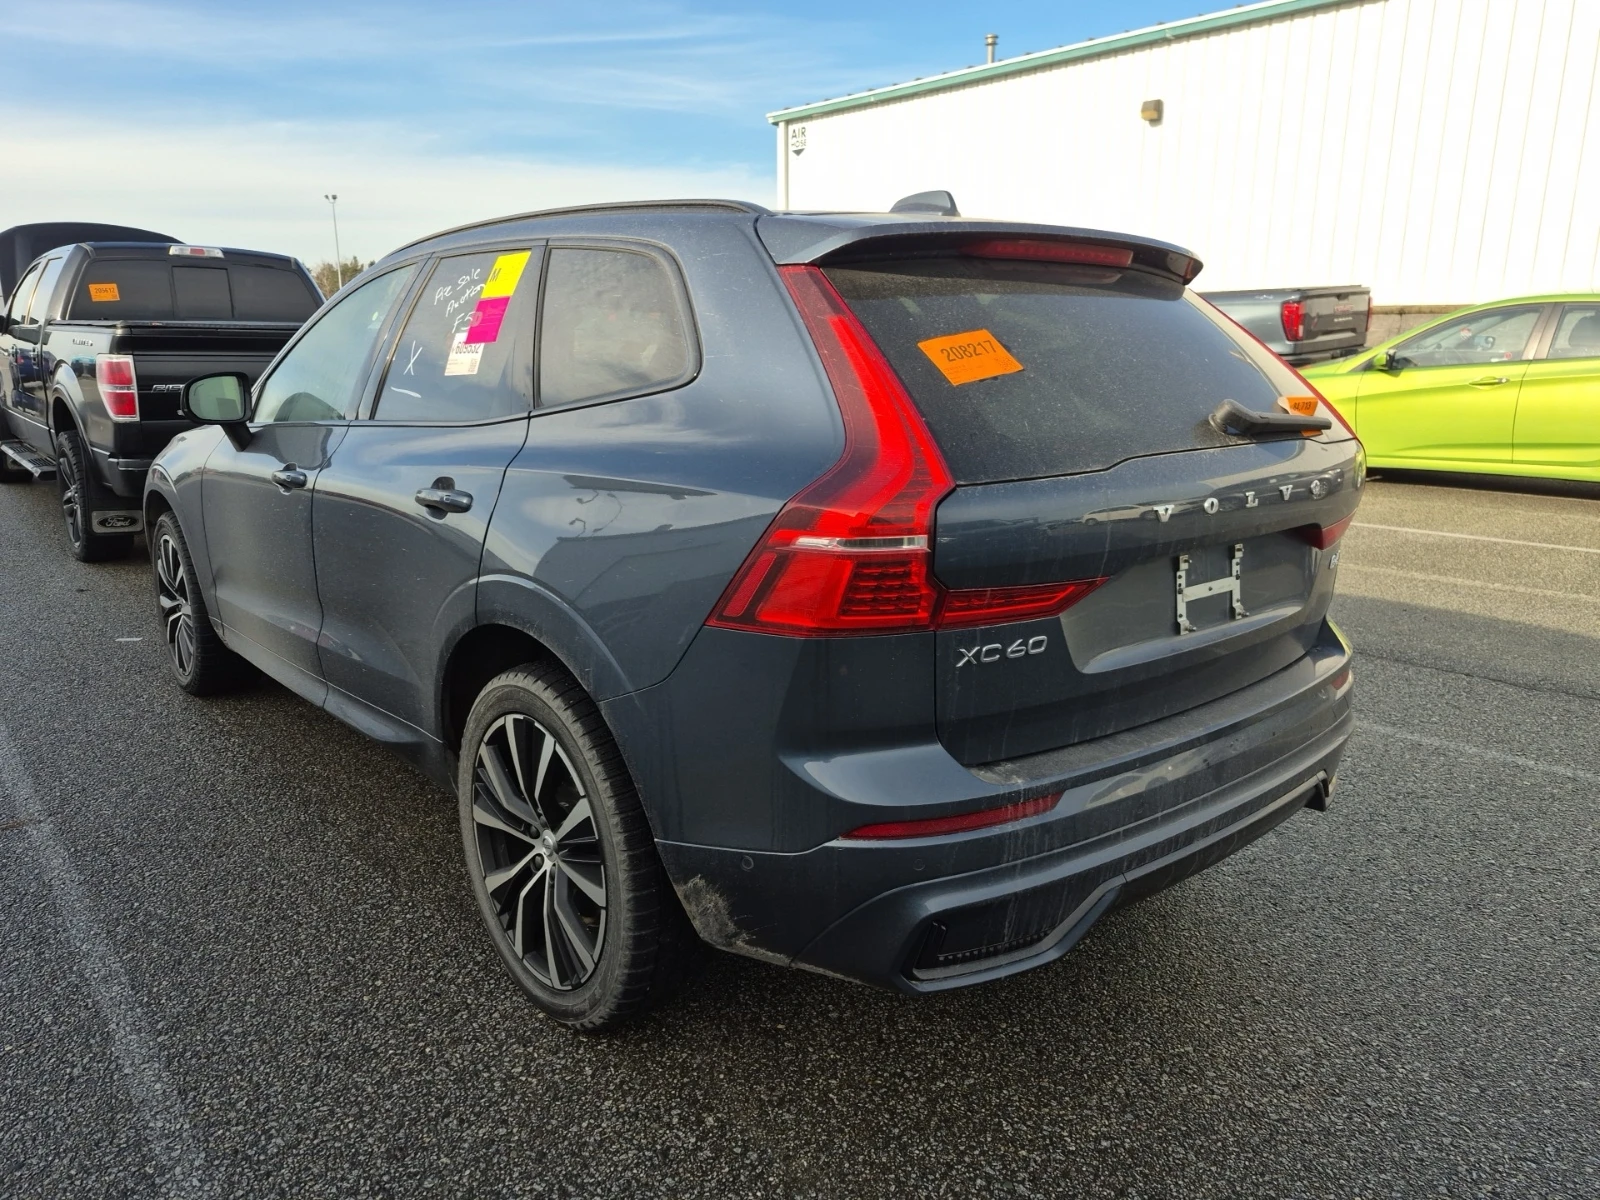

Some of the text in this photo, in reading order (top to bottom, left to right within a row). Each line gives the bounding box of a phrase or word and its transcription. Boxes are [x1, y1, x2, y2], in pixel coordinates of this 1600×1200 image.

[791, 126, 806, 139] AIR
[940, 340, 997, 362] 208217
[1152, 479, 1322, 523] VOLVO
[955, 635, 1048, 667] XC60
